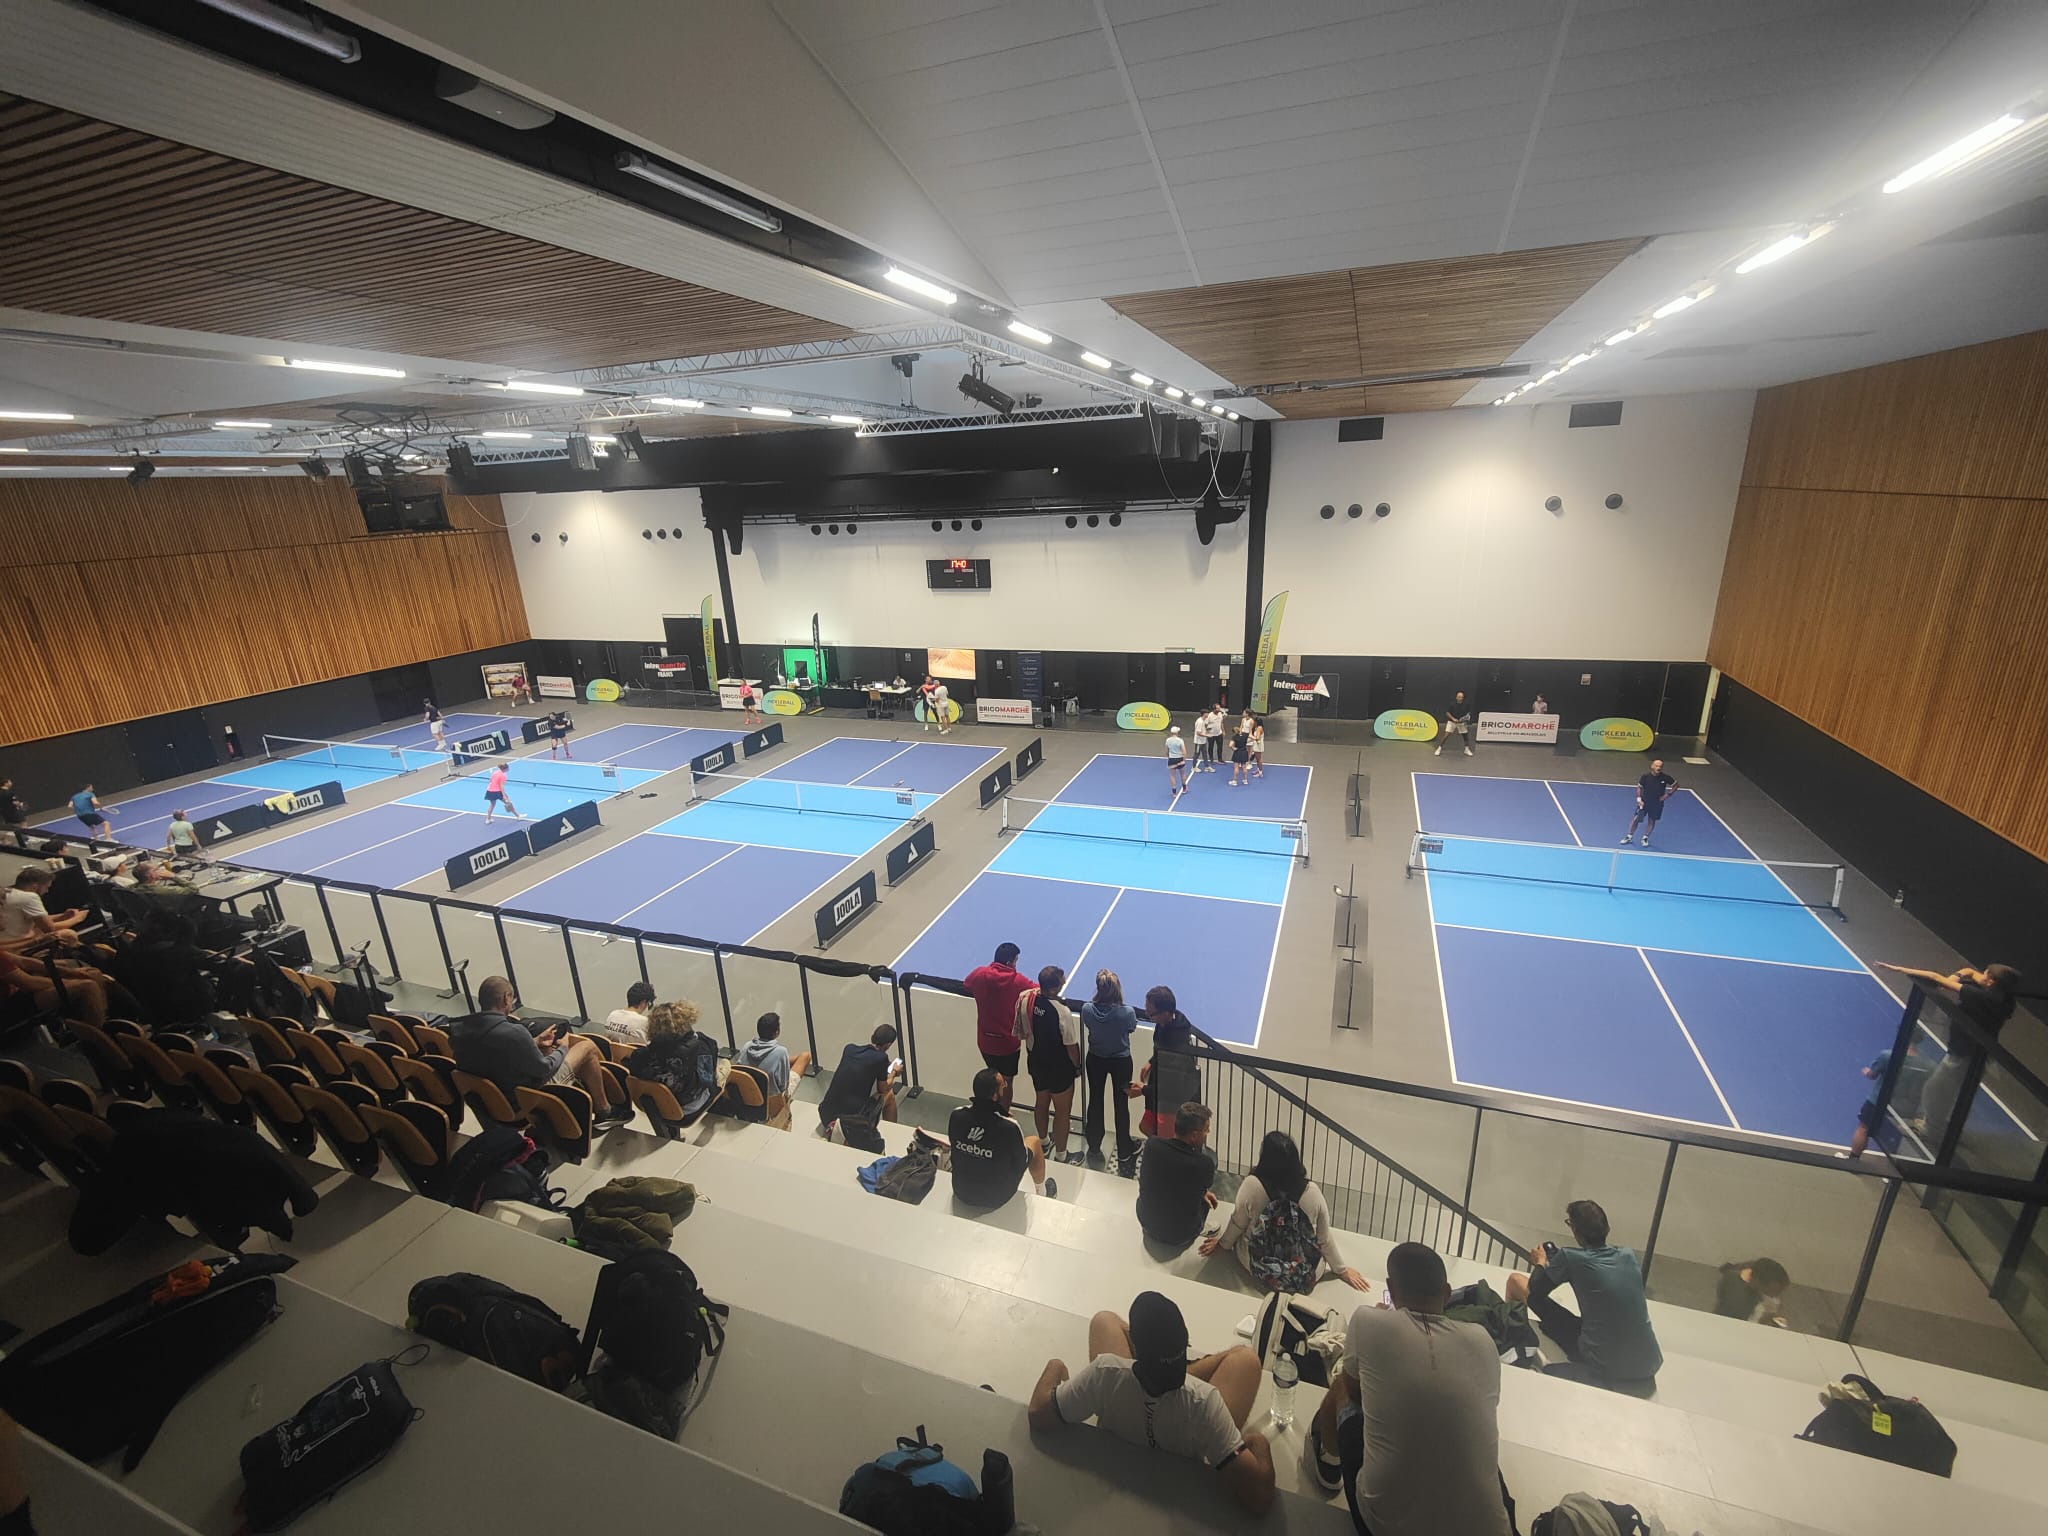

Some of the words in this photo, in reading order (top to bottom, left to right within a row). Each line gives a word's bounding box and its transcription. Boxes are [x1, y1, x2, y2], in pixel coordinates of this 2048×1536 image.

[1257, 626, 1272, 677] PICKLEBALL
[1290, 692, 1314, 702] FRANS
[1383, 720, 1428, 729] PICKLEBALL
[1591, 730, 1642, 738] PICKLEBALL
[470, 741, 495, 755] JOOLA
[705, 753, 723, 770] JOOLA
[473, 846, 507, 871] JOOLA
[836, 892, 860, 922] JOOLA
